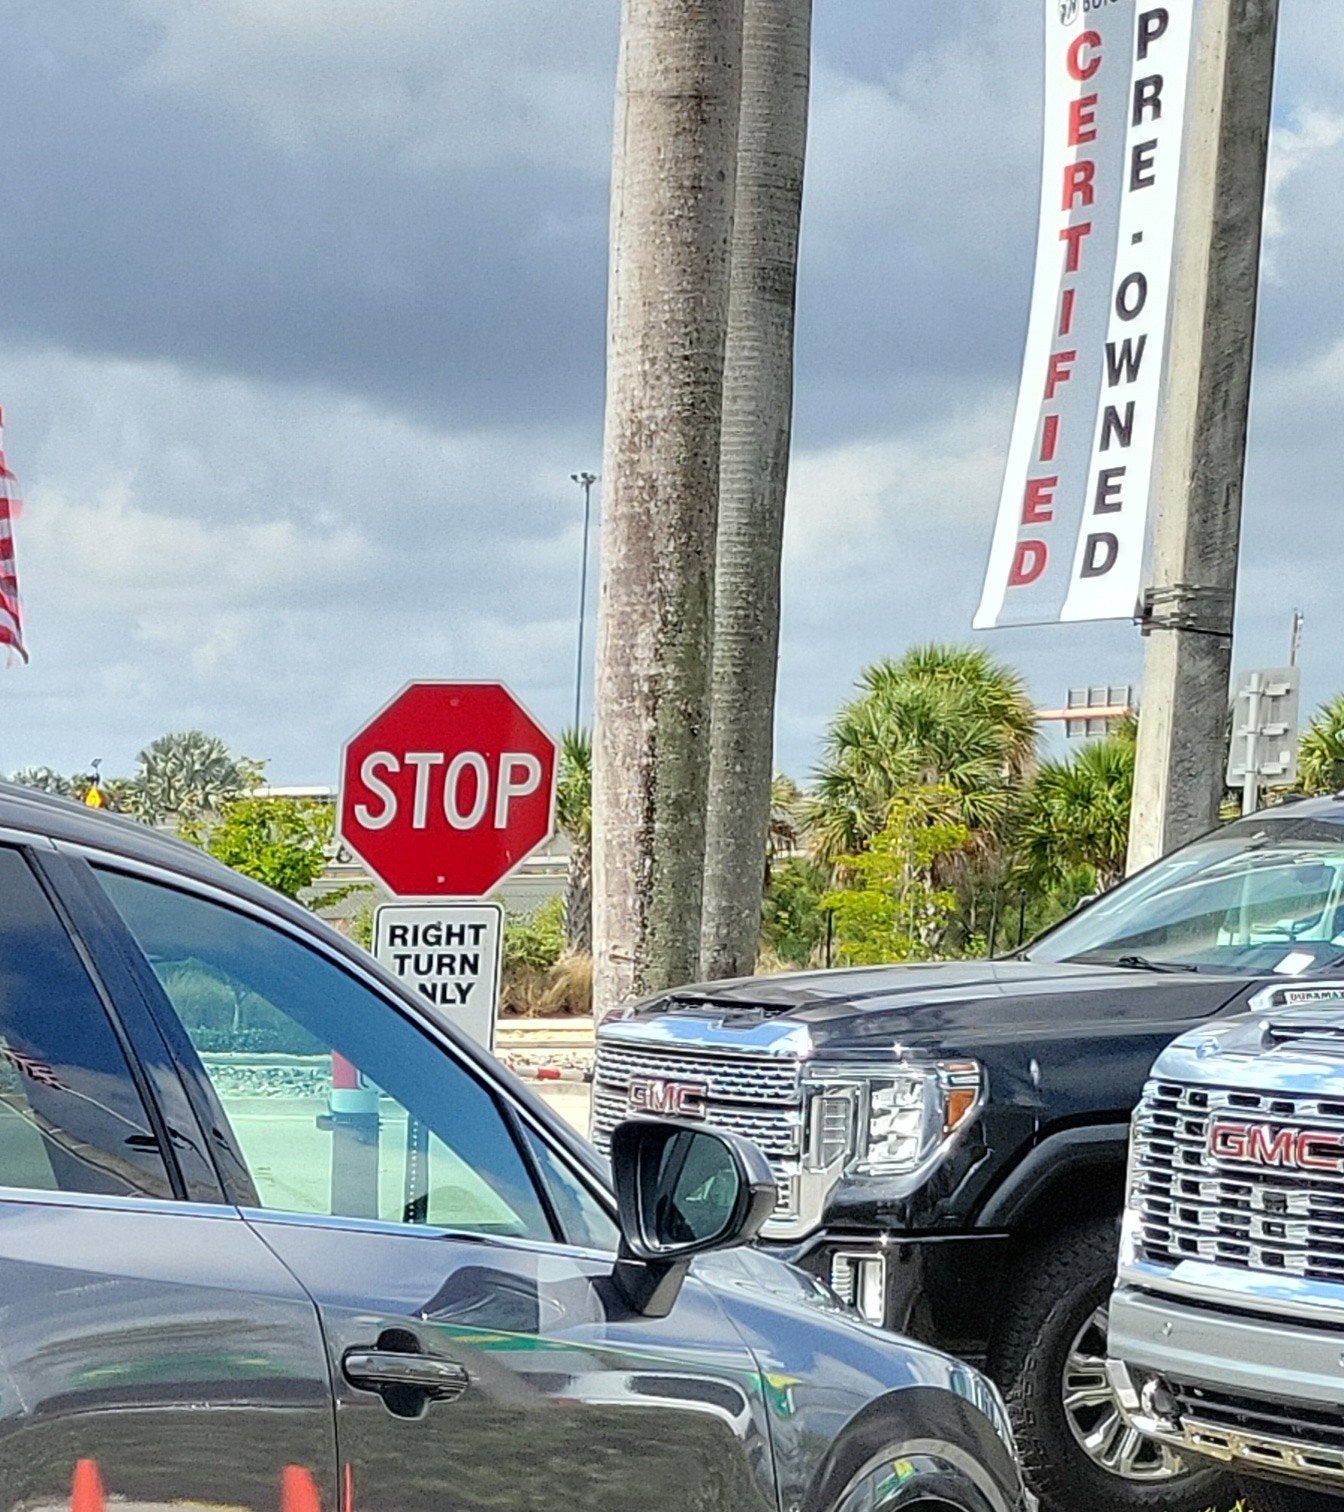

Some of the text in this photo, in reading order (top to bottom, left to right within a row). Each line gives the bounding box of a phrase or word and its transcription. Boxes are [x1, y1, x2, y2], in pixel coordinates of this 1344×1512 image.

[1007, 30, 1102, 588] CERTIFIED
[354, 751, 542, 831] STOP
[388, 923, 487, 948] RIGHT
[393, 954, 480, 976] TURN
[418, 982, 476, 1005] NLY
[630, 1080, 707, 1119] GMC
[1210, 1121, 1344, 1173] GMC
